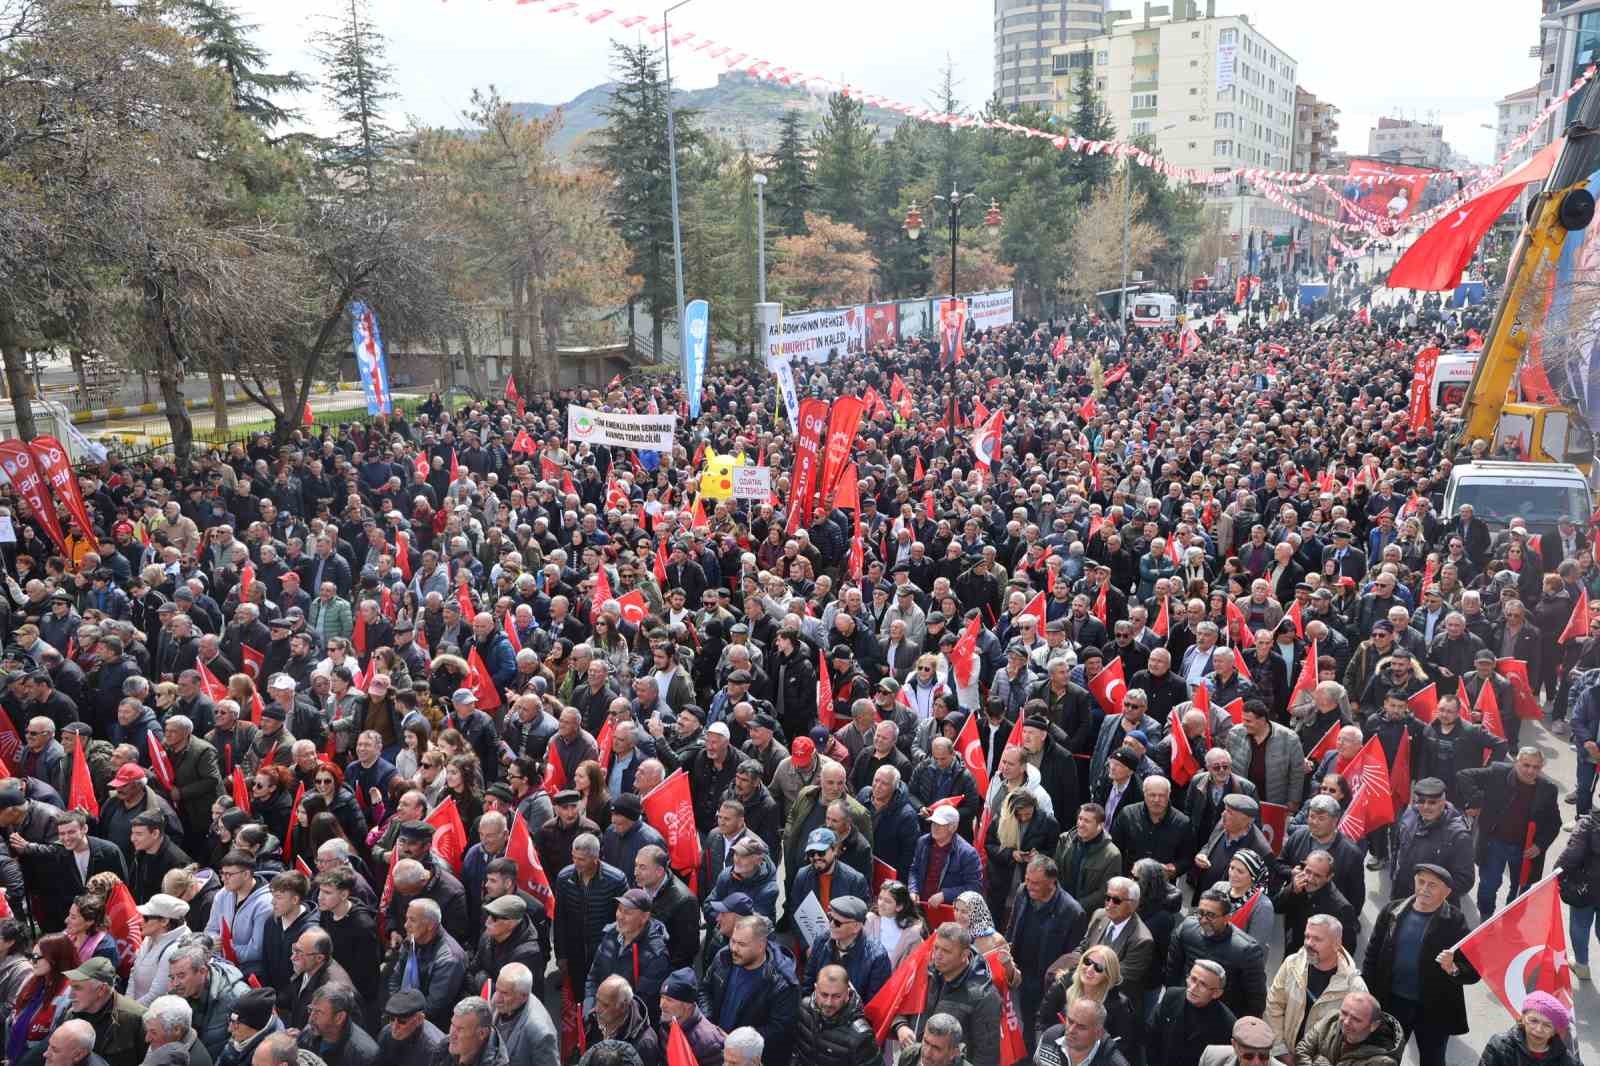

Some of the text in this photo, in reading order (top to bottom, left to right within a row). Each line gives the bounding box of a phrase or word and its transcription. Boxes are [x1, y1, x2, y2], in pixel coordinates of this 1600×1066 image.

[594, 416, 672, 433] TÜM EMEKLİLERİN SENDİKASI
